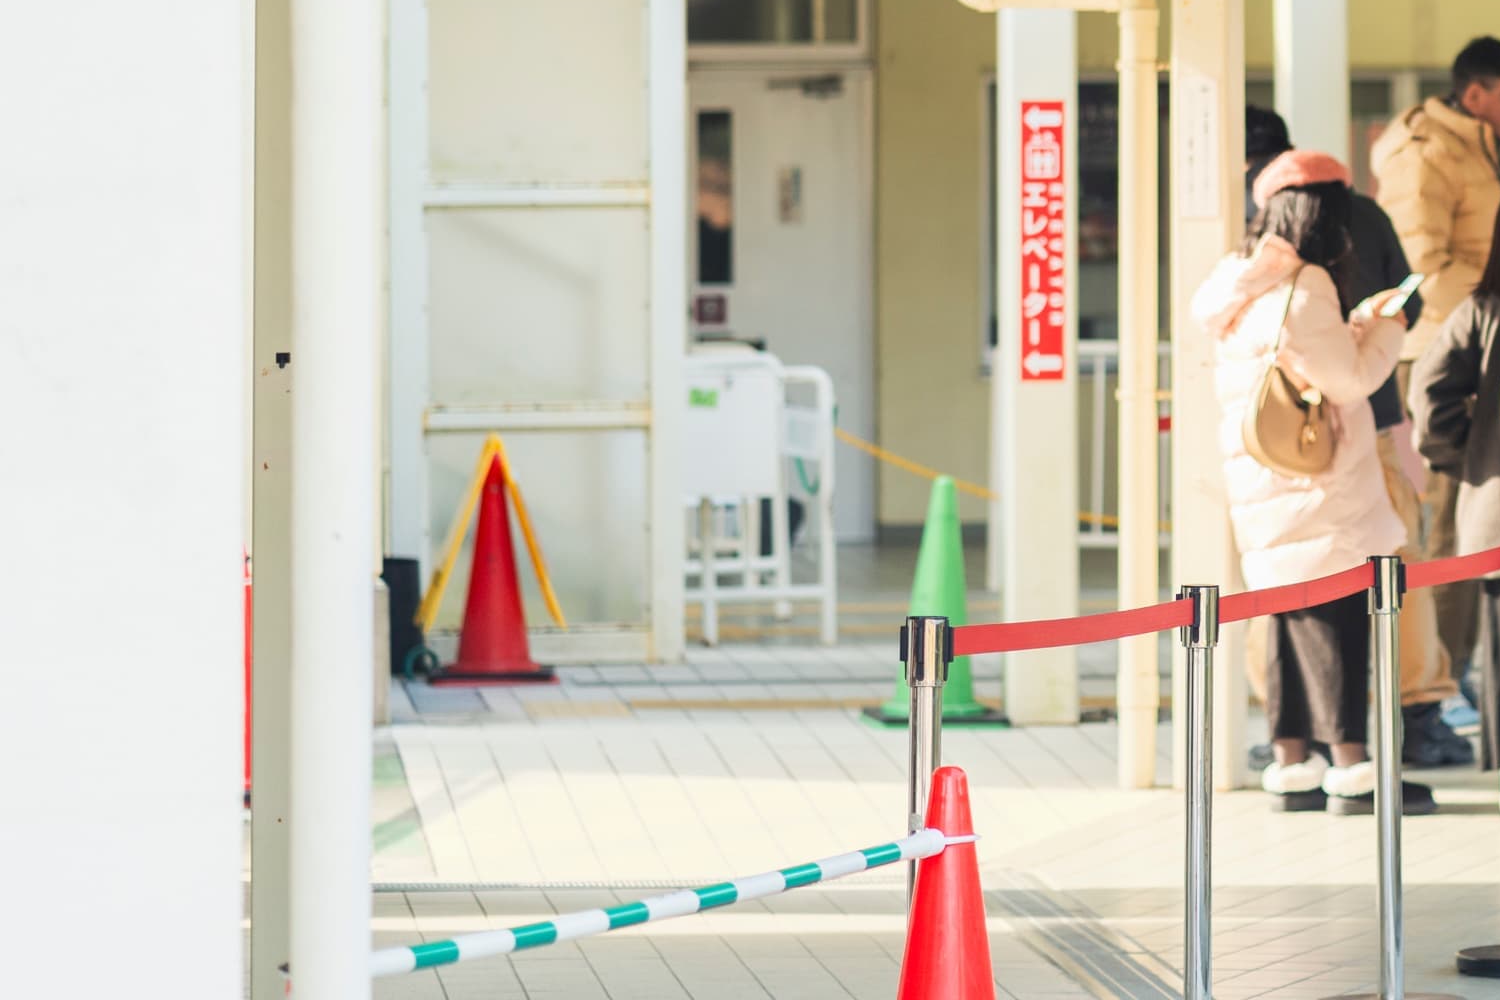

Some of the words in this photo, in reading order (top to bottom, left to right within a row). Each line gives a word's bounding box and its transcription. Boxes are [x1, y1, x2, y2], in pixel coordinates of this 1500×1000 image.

[1022, 182, 1048, 346] エレベーター
